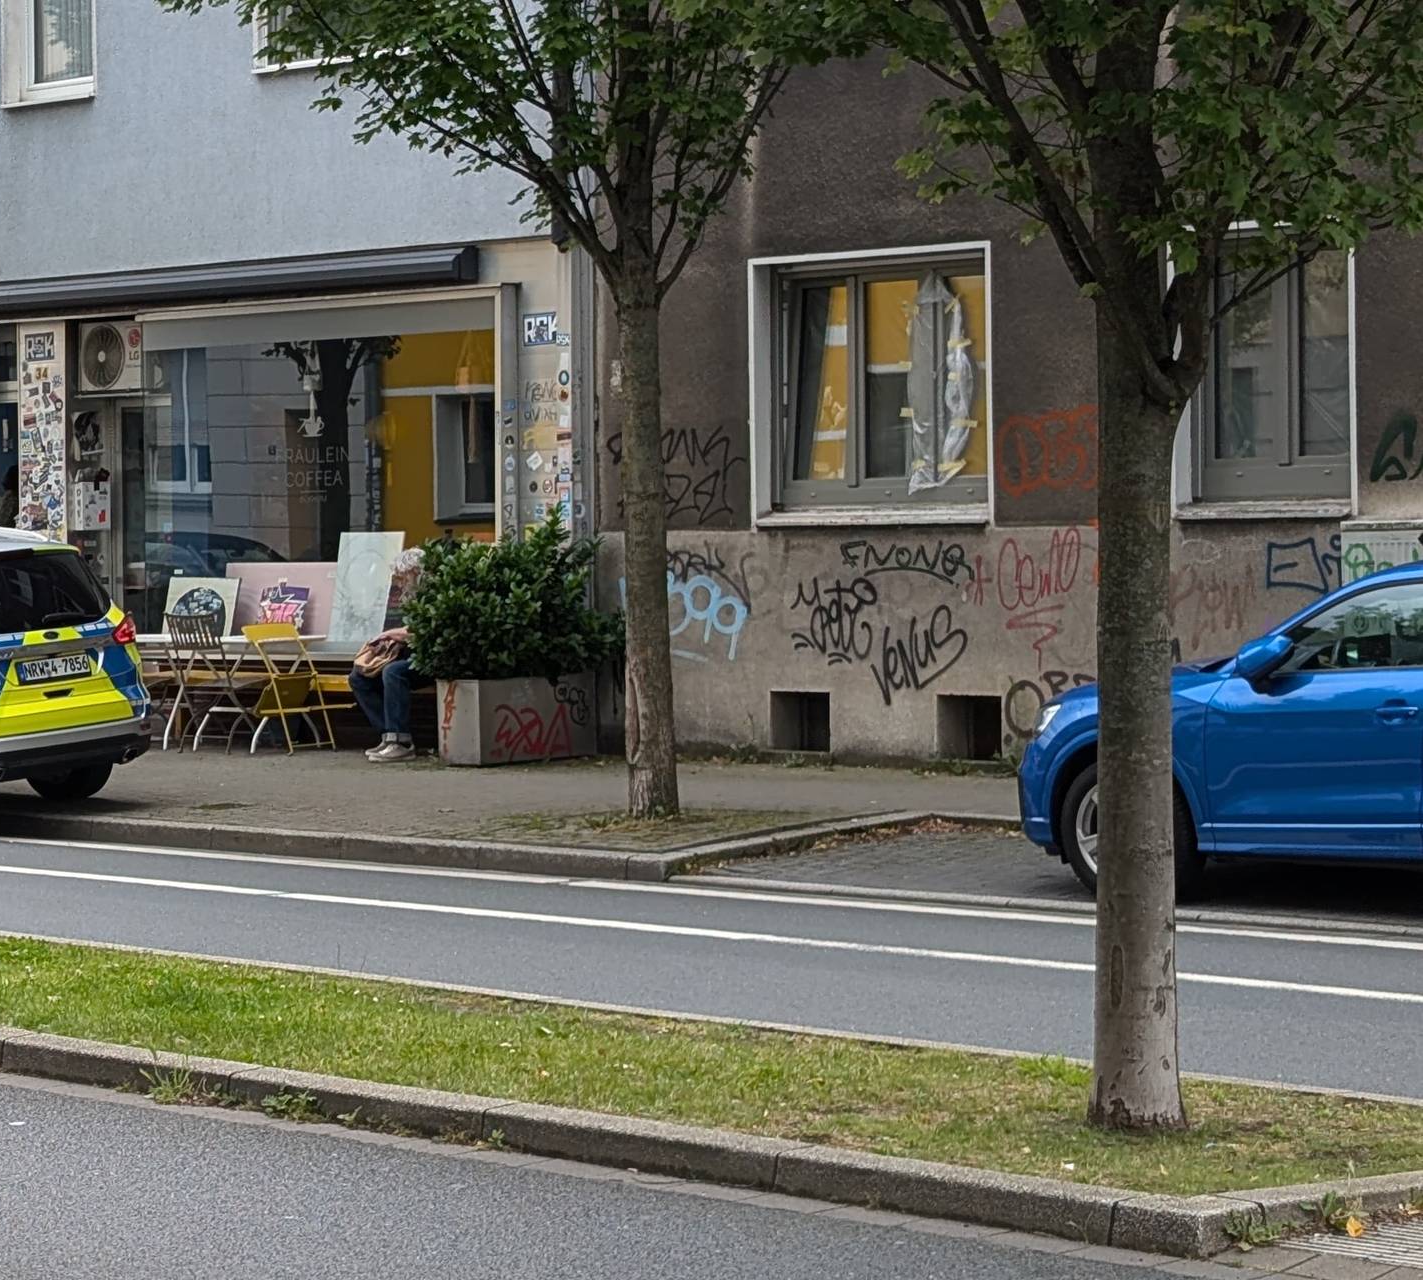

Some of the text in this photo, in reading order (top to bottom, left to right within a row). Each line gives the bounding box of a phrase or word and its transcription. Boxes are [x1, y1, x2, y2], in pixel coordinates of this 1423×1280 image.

[35, 367, 48, 380] 34
[278, 444, 348, 464] FRÄULEIN
[286, 470, 343, 487] COFFEA
[26, 656, 88, 681] NRW 4-7856
